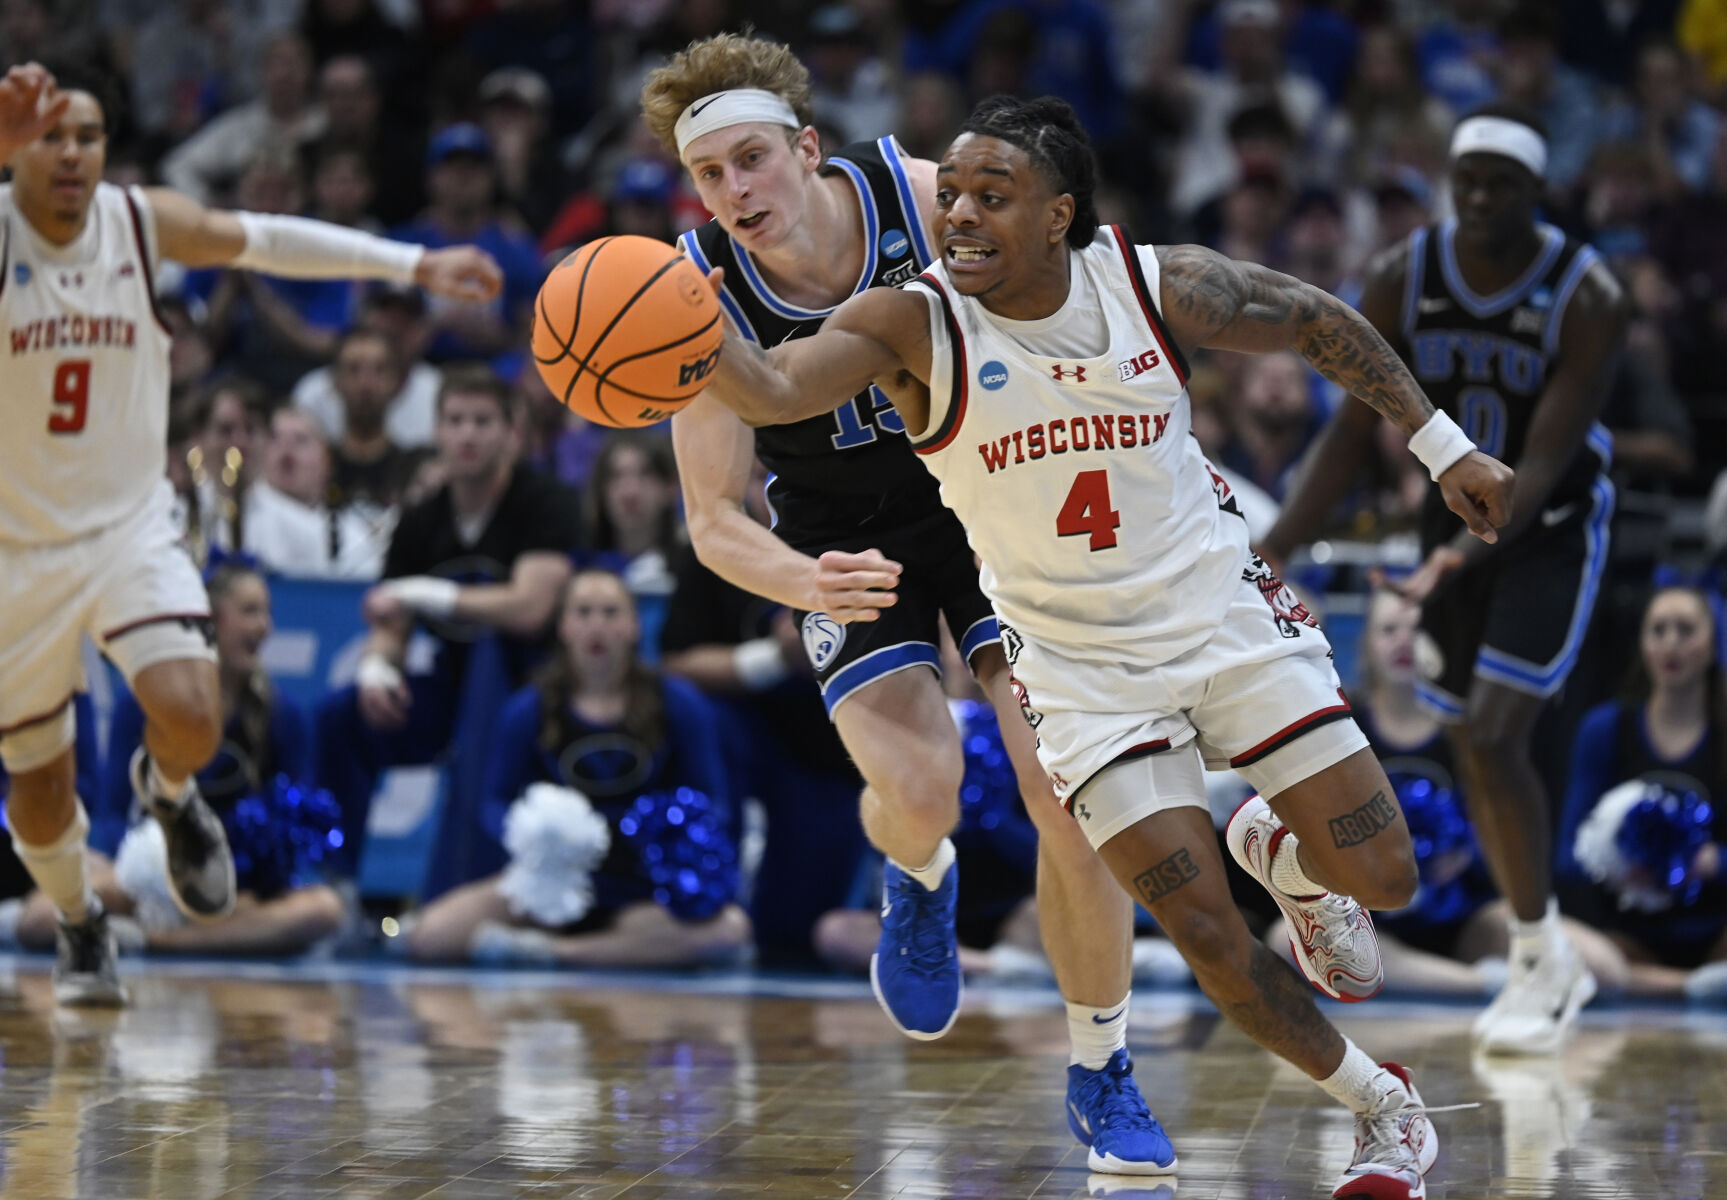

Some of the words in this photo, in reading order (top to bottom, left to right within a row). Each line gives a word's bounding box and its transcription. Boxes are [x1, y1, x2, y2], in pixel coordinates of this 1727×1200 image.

[11, 314, 136, 357] WISCONSIN
[1118, 349, 1160, 382] BIG
[1413, 328, 1546, 395] BYU
[48, 359, 92, 435] 9
[983, 373, 1008, 385] NCAA
[978, 411, 1170, 474] WISCONSIN
[1457, 386, 1508, 460] 0
[1056, 468, 1121, 552] 4
[1328, 790, 1398, 849] ABOVE
[1133, 848, 1201, 905] RISE
